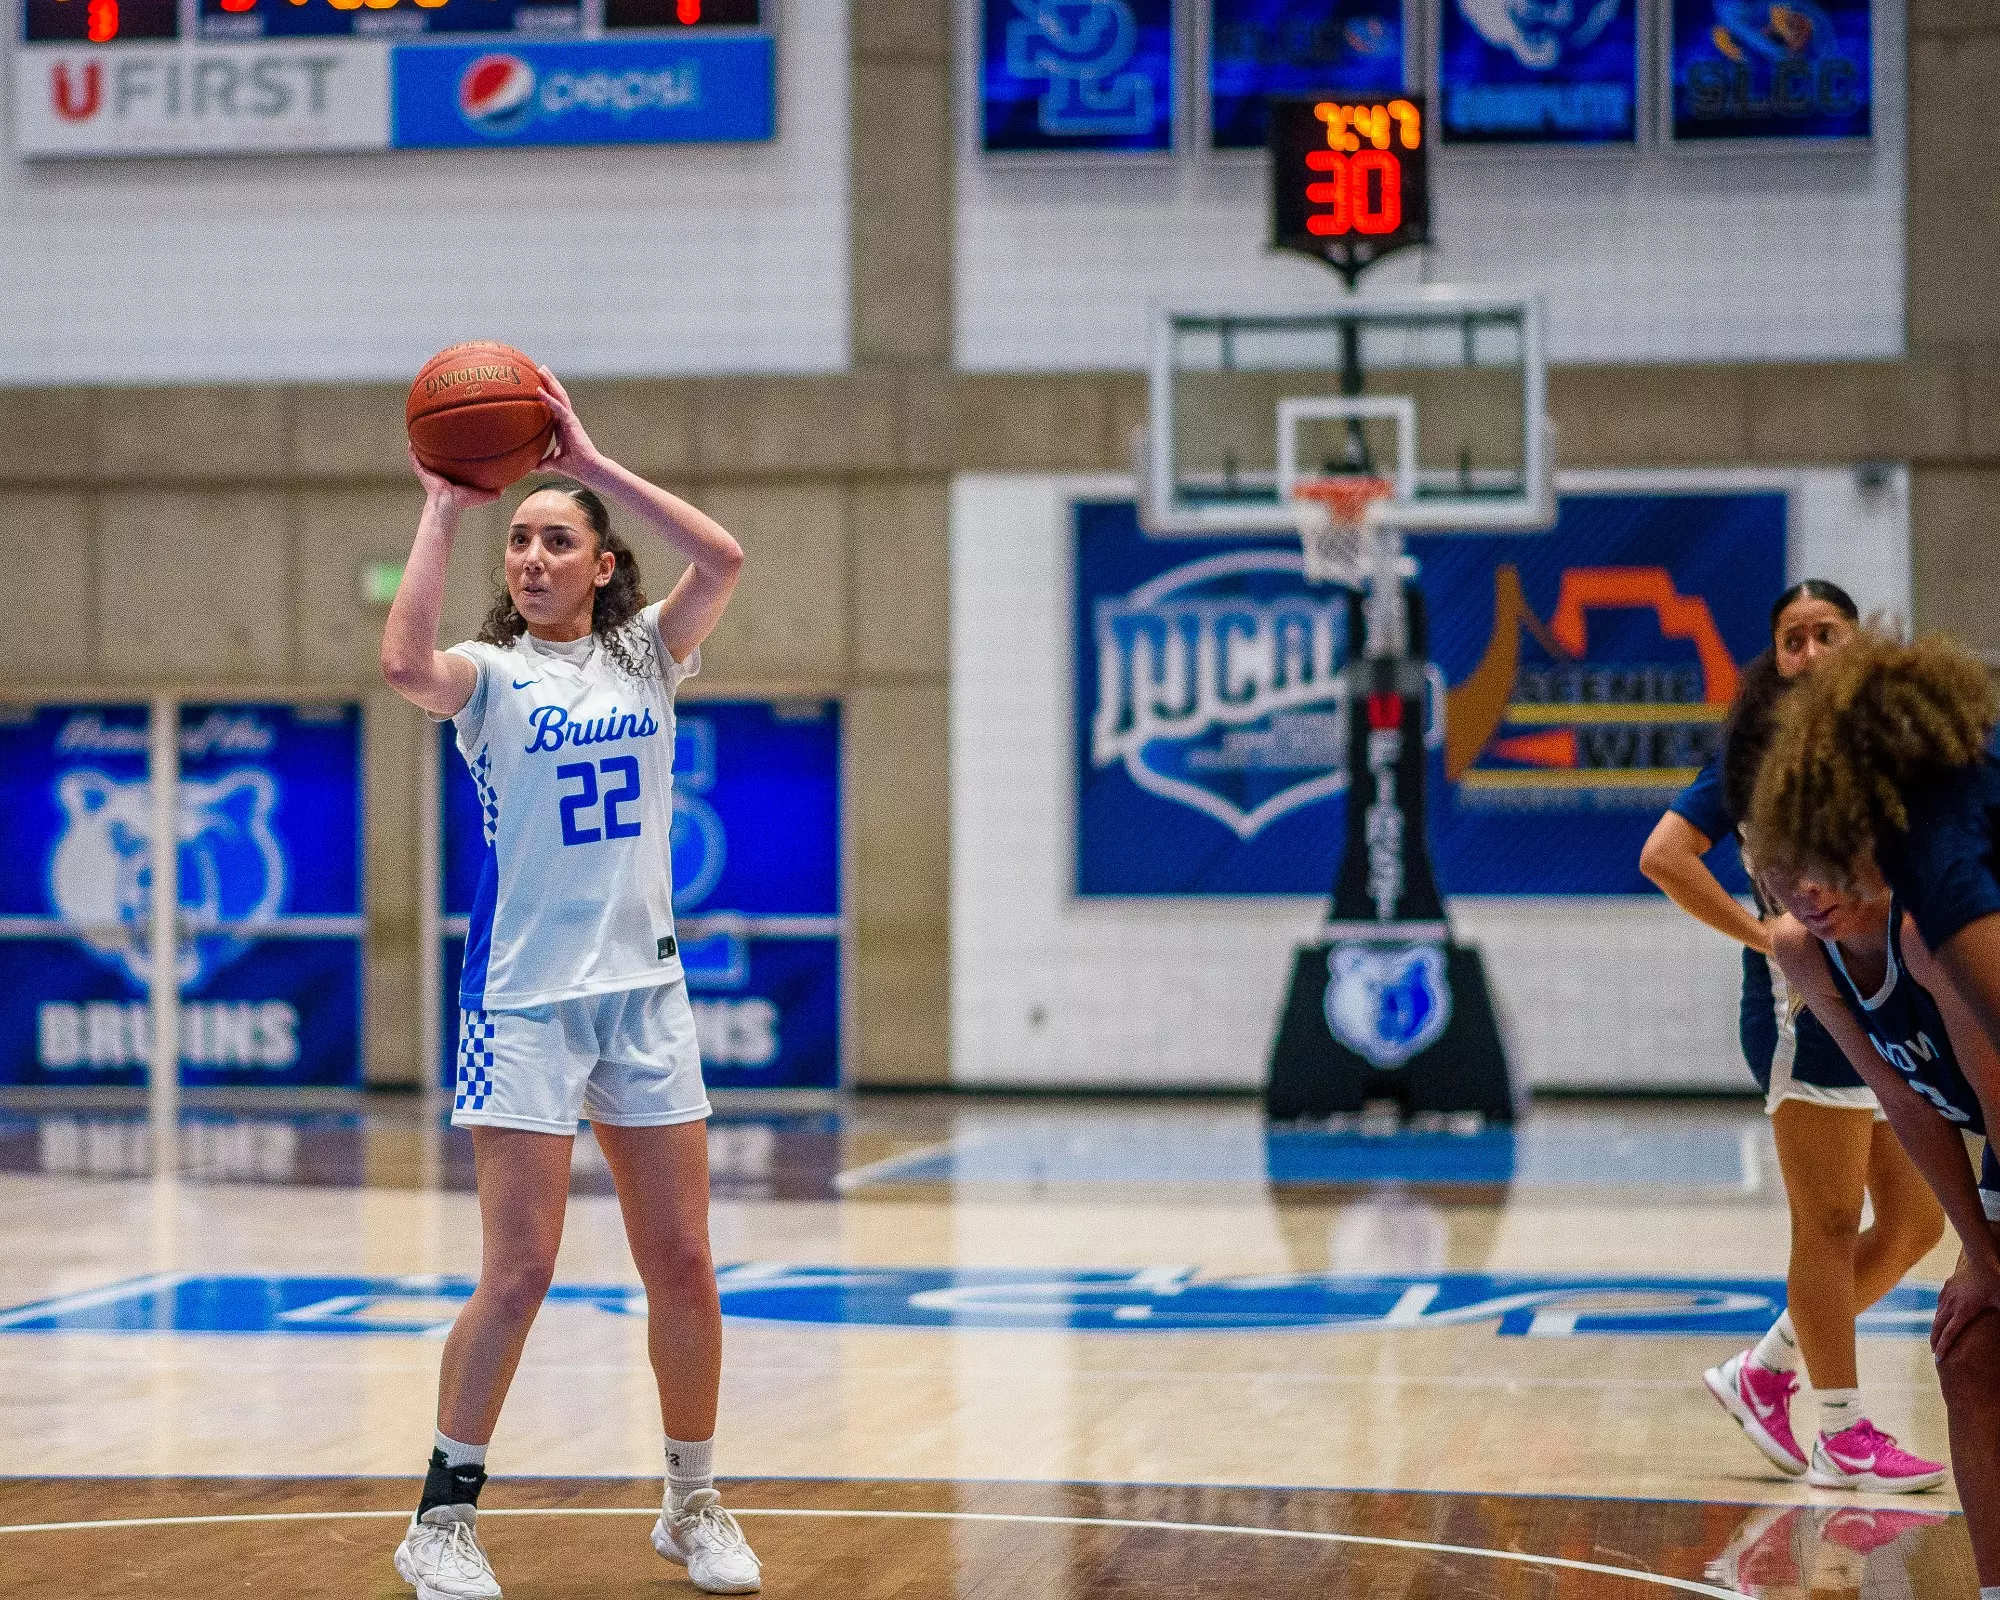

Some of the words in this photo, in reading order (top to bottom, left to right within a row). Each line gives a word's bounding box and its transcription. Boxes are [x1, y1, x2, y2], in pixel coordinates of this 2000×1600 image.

[539, 60, 698, 118] pepsi
[1305, 150, 1402, 236] 30
[425, 364, 522, 400] SPALDING
[525, 705, 658, 753] Bruins
[556, 755, 641, 846] 22
